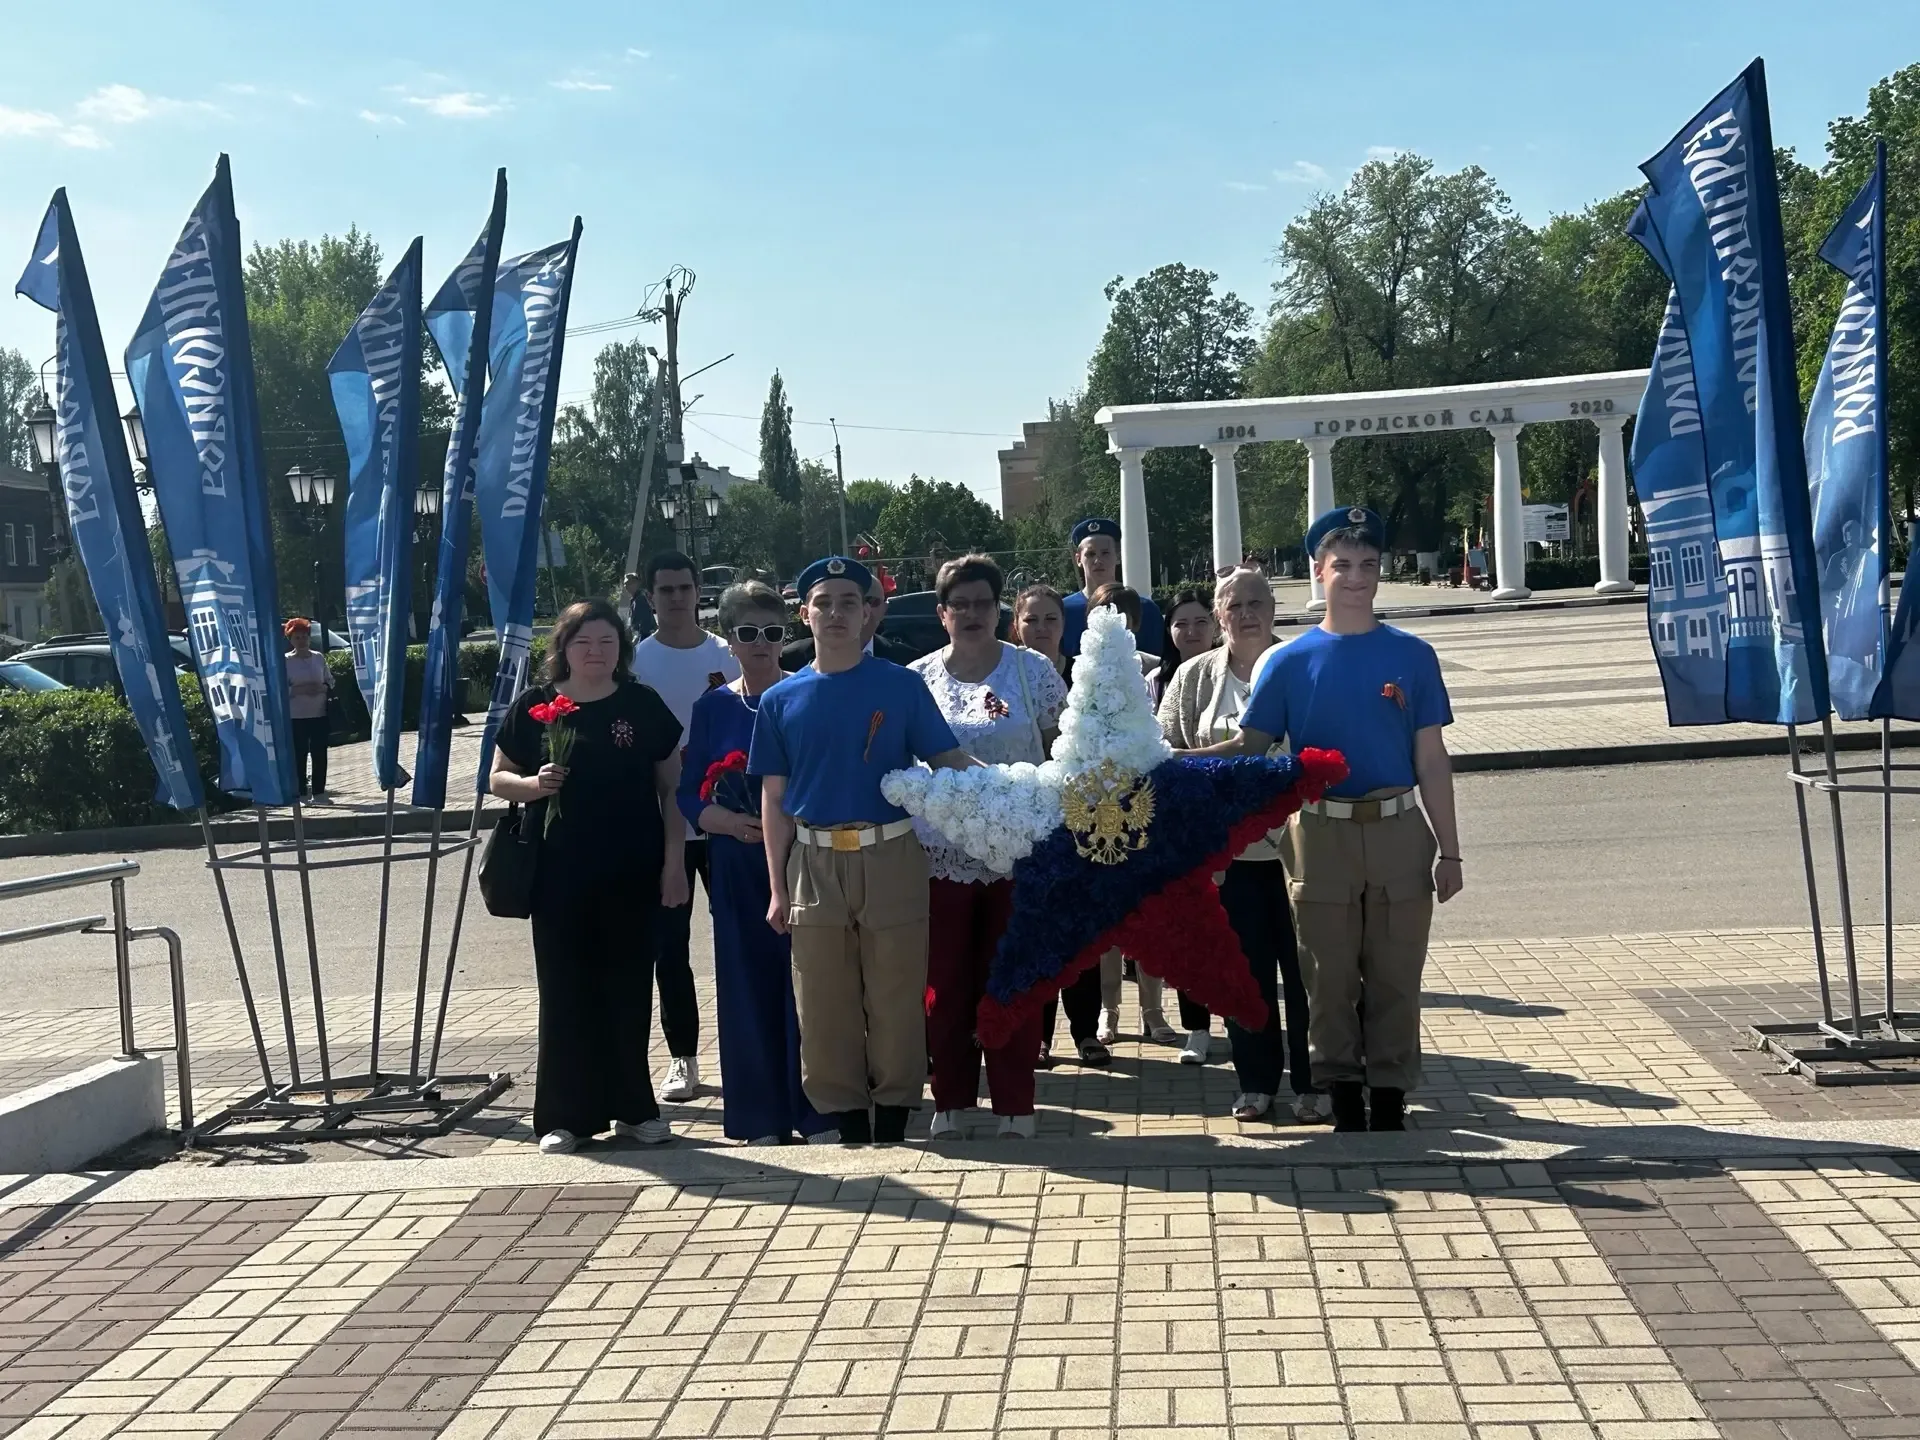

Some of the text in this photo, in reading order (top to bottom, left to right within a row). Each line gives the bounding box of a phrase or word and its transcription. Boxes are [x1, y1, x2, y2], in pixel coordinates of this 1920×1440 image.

[1570, 399, 1615, 415] 2020
[1314, 407, 1516, 435] ГОРОДСКОЙ САД
[1218, 425, 1257, 440] 1904
